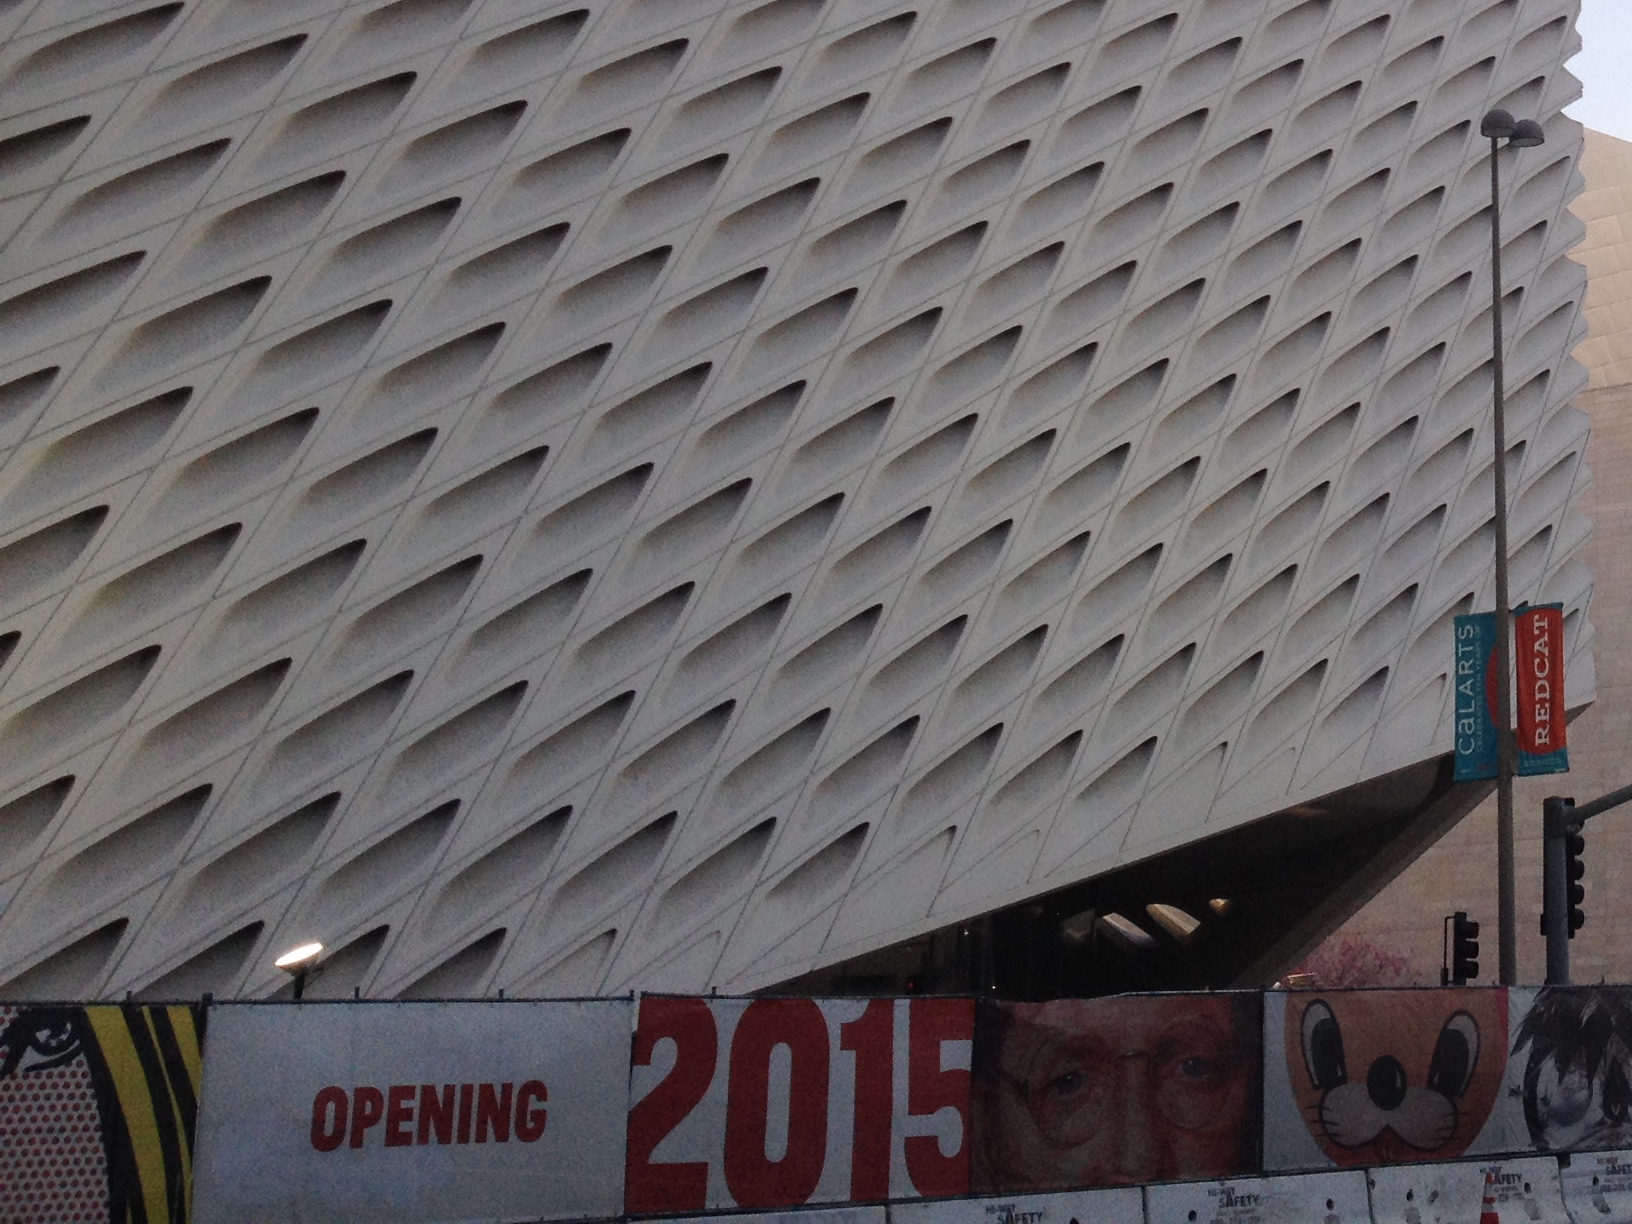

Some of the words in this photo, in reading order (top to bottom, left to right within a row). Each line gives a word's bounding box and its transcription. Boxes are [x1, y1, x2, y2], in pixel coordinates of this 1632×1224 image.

[1533, 614, 1550, 746] REDCAT
[1475, 693, 1483, 753] CELEBRATES
[310, 1079, 548, 1152] OPENING
[625, 997, 974, 1213] 2015
[1218, 1192, 1260, 1209] SAFETY
[1494, 1171, 1523, 1185] AFETY
[998, 1207, 1043, 1224] SAFETY
